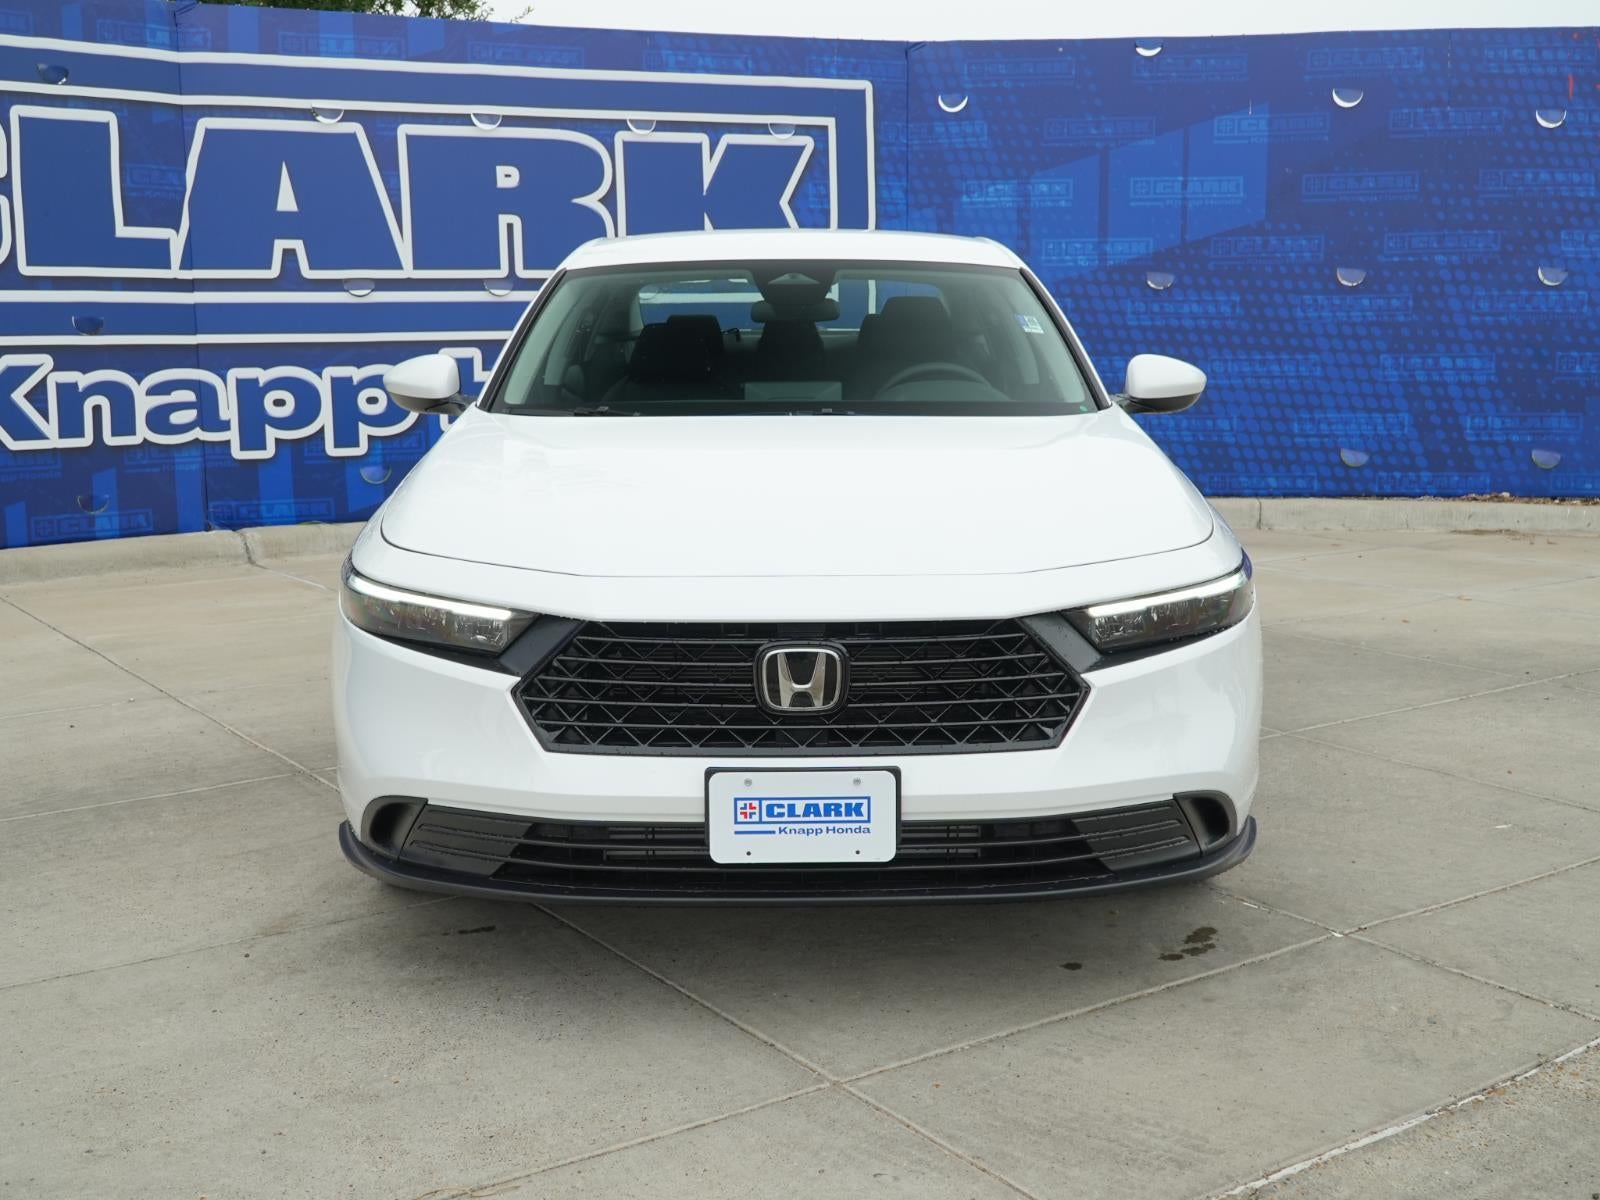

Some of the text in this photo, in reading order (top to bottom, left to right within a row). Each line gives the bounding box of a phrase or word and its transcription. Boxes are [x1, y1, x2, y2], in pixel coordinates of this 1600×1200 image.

[0, 104, 814, 280] LARK
[766, 803, 864, 818] CLARK
[778, 825, 871, 836] Knapp Honda
